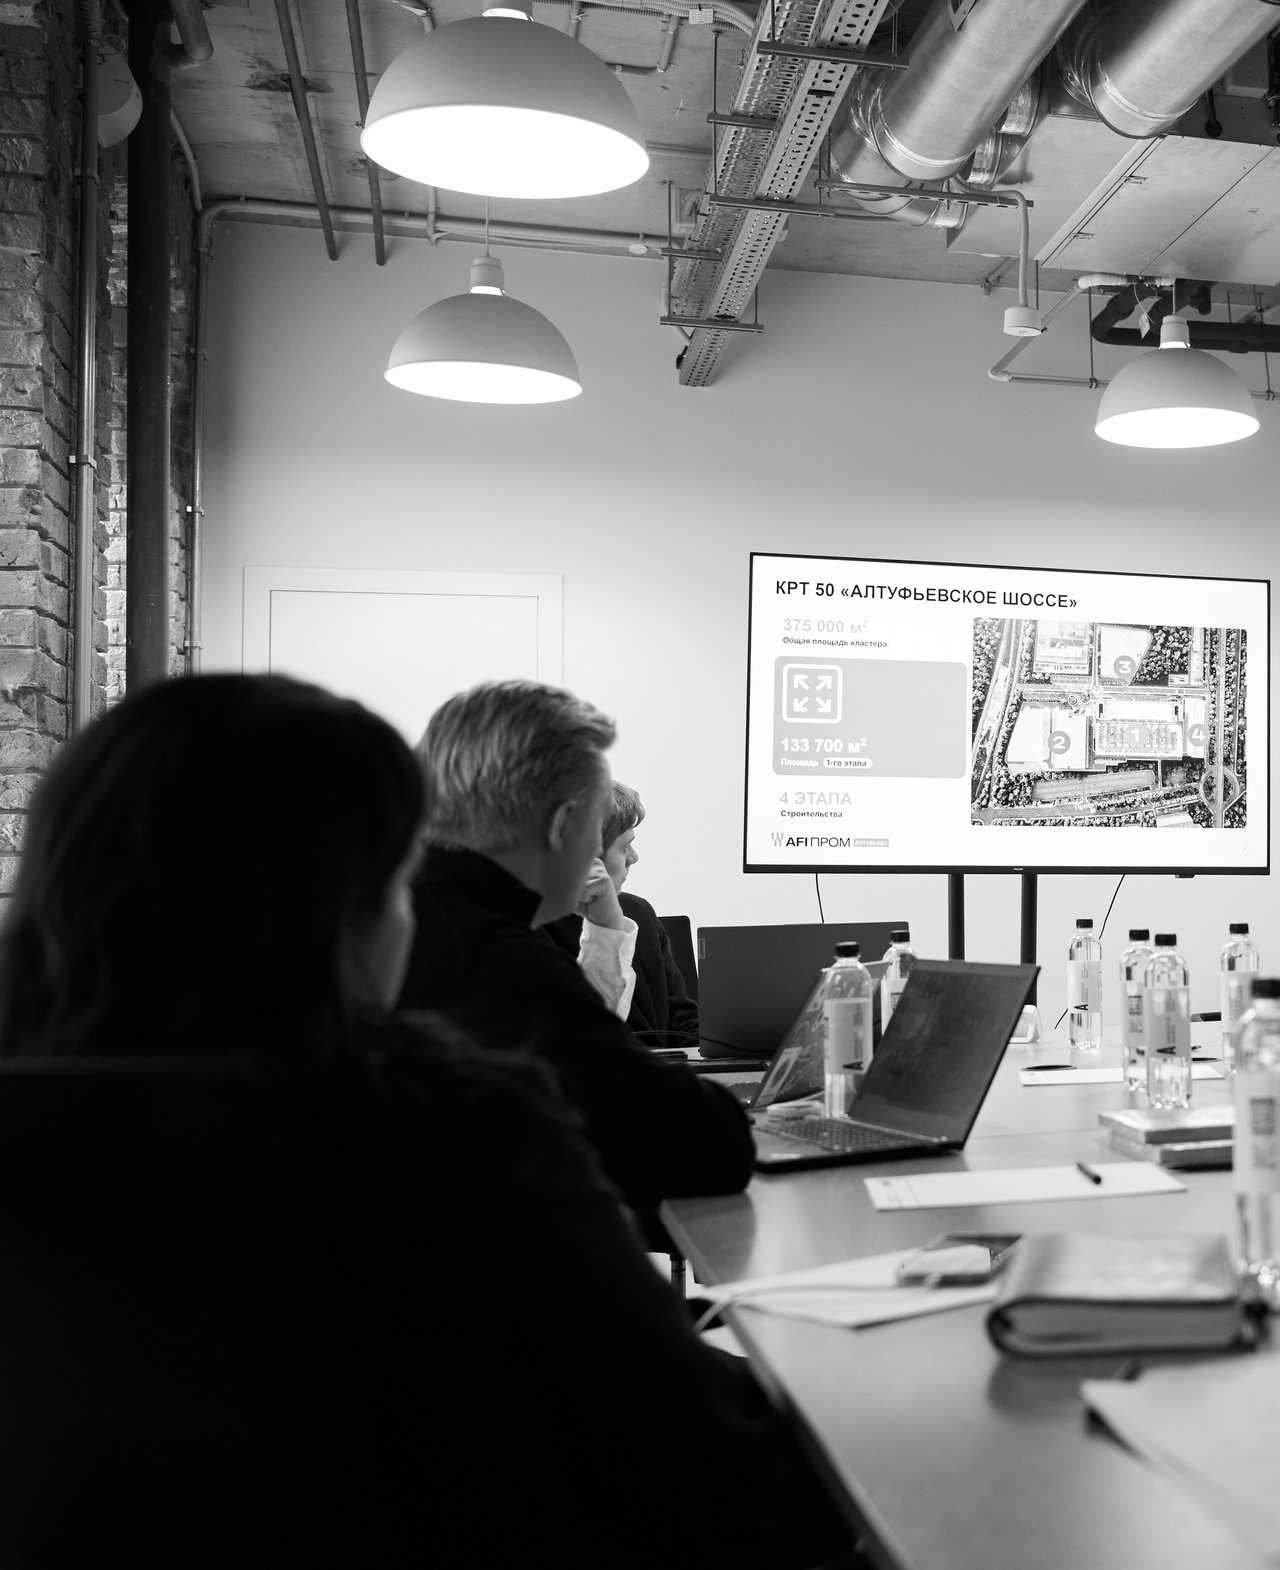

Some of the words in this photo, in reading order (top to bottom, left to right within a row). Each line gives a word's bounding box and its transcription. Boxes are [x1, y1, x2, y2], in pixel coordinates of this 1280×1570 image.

[776, 580, 810, 595] КРТ
[815, 583, 835, 597] 50
[841, 584, 997, 604] «АЛТУФЬЕВСКОЕ
[1003, 591, 1077, 608] ШОССЕ»
[783, 618, 812, 632] 375
[816, 619, 845, 633] 000
[782, 636, 811, 645] Общая
[812, 638, 849, 647] площадь
[850, 640, 888, 648] кластера
[1118, 660, 1132, 673] 3
[1131, 729, 1140, 742] 1
[1191, 728, 1206, 742] 4
[781, 737, 810, 752] 133
[813, 738, 844, 753] 700
[1053, 736, 1066, 749] 2
[779, 791, 789, 804] 4
[794, 791, 852, 805] ЭТАПА
[780, 809, 843, 818] Строительства
